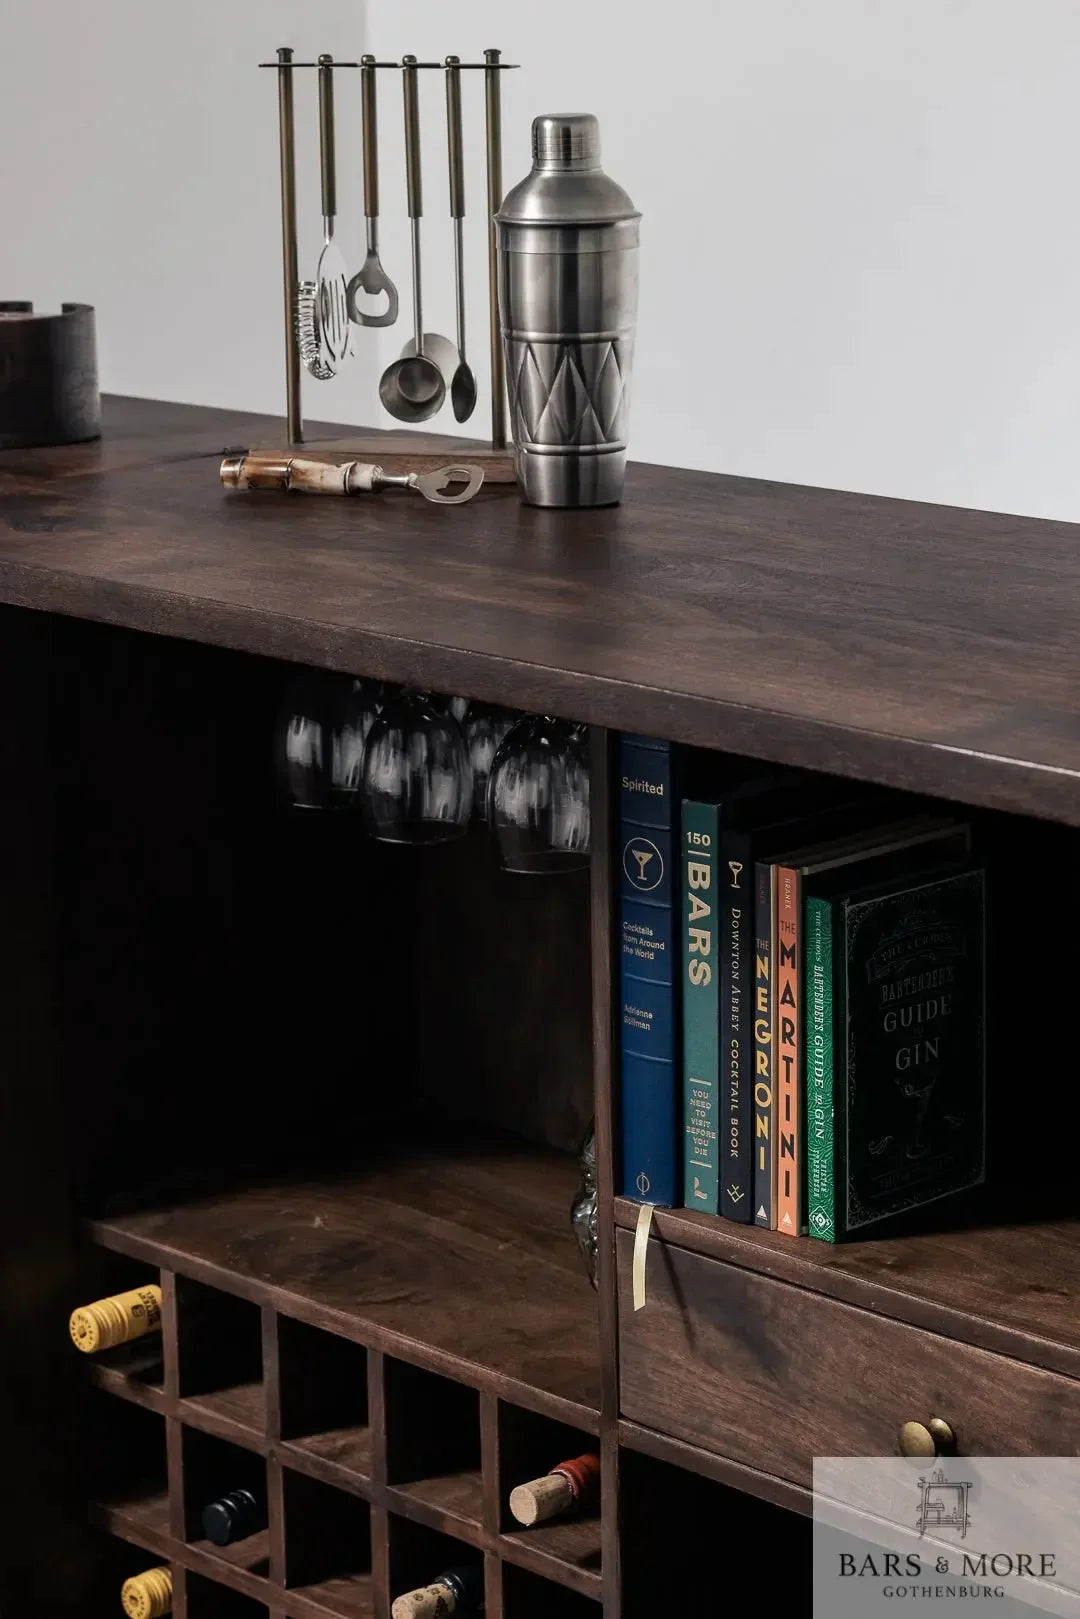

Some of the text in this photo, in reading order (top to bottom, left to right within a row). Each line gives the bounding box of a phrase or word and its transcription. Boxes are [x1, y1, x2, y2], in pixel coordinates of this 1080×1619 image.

[622, 776, 664, 796] Spirited
[686, 831, 711, 847] 150
[784, 878, 792, 910] HRANEK
[623, 921, 654, 937] Cocktails
[688, 861, 711, 987] BARS
[780, 919, 796, 935] THE
[623, 944, 655, 961] the World
[640, 938, 665, 951] Around
[757, 938, 769, 951] THE
[883, 995, 953, 1033] GUIDE
[731, 908, 741, 1159] DOWNTON ABBEY COCKTAIL BOOK
[755, 954, 771, 1171] NEGRONI
[814, 1034, 824, 1089] GUIDE
[896, 1038, 942, 1071] GIN
[780, 939, 796, 1198] MARTINI
[692, 1088, 709, 1099] YOU
[690, 1098, 712, 1110] NEED
[695, 1109, 706, 1118] TO
[691, 1117, 711, 1128] VISIT
[815, 1108, 824, 1140] GIN
[685, 1125, 717, 1140] BEFORE
[692, 1136, 709, 1147] YOU
[694, 1146, 708, 1156] DIE
